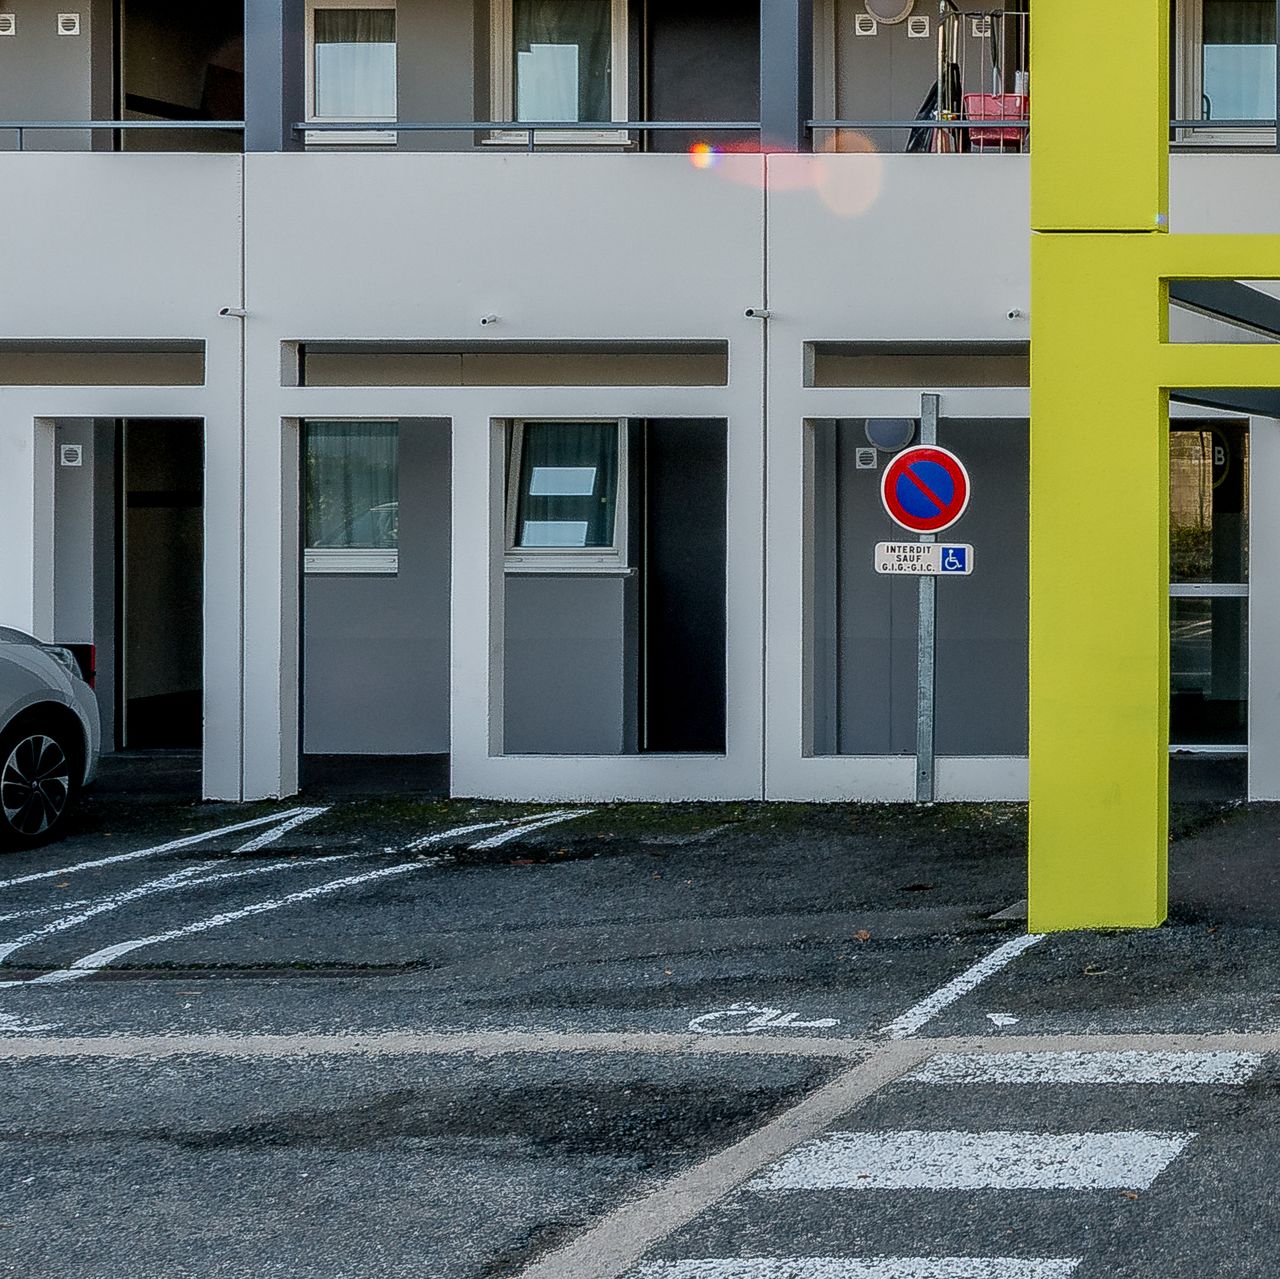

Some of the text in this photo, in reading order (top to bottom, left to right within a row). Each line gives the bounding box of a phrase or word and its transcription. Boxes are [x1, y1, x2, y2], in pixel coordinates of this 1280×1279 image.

[886, 545, 932, 554] INTERDIT
[896, 555, 922, 563] SAUF
[881, 563, 936, 572] G.I.G.-G.I.C.
